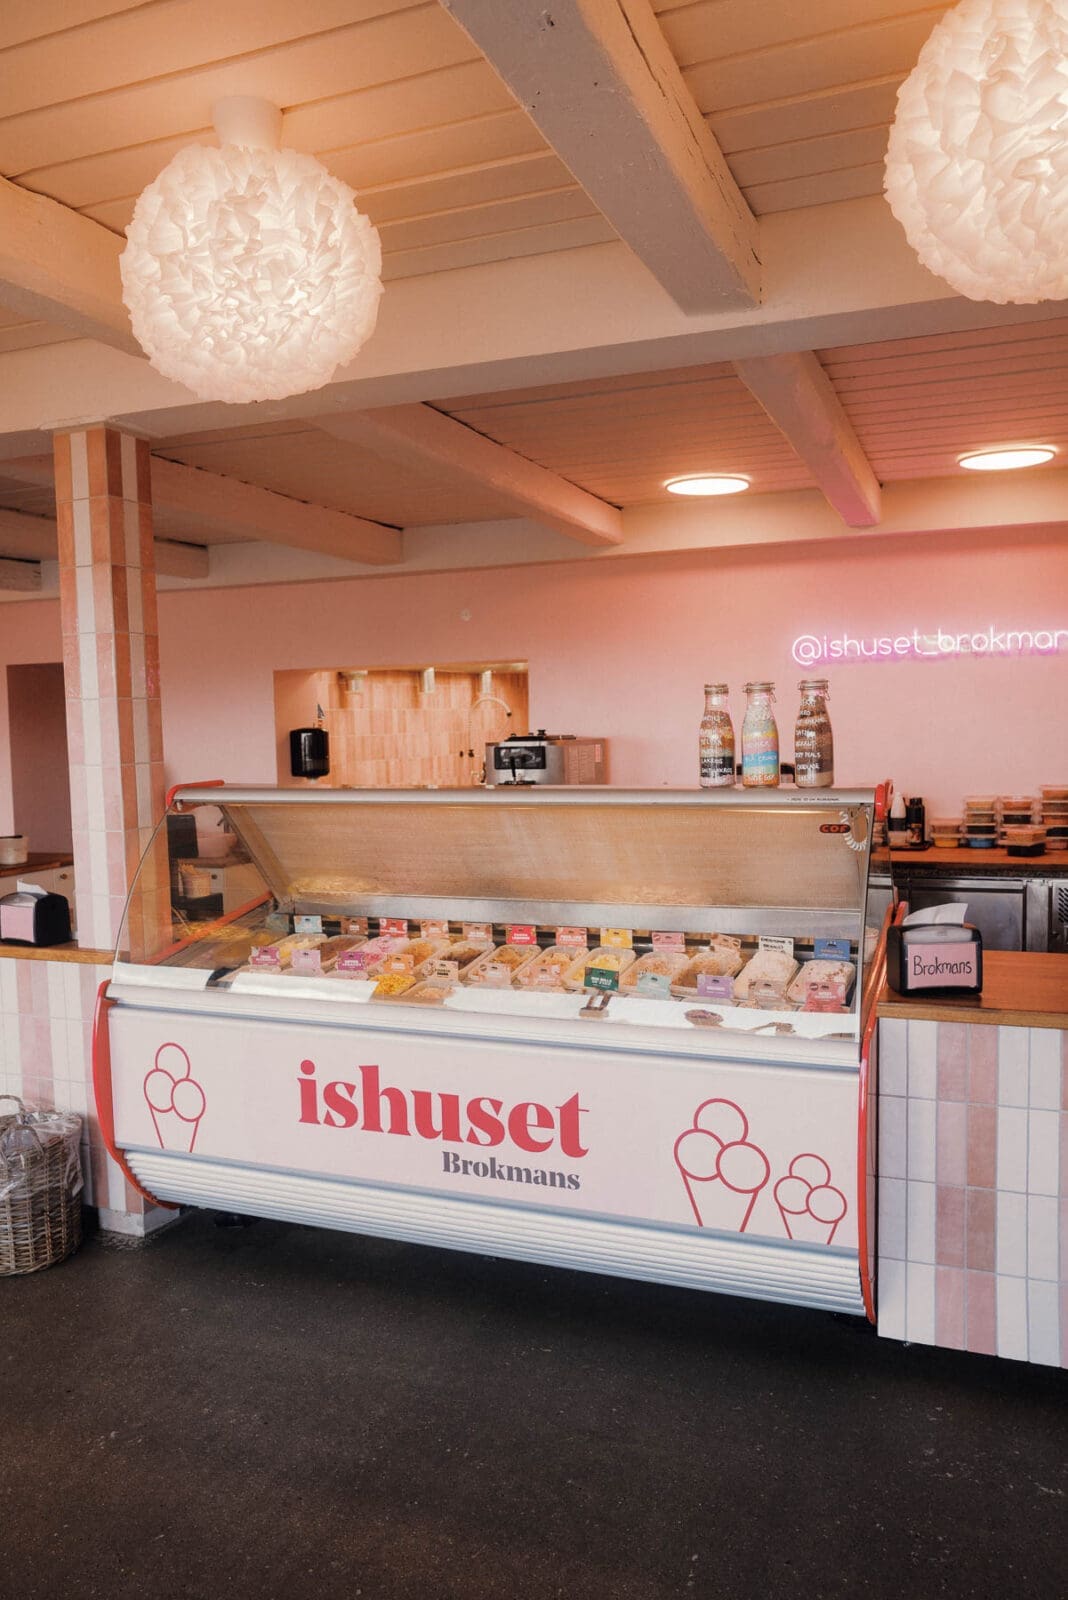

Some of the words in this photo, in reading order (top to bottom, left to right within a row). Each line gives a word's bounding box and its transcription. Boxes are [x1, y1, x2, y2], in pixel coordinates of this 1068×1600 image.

[913, 955, 973, 976] Brokmans
[297, 1059, 590, 1158] ishuset
[442, 1151, 582, 1190] Brokmans
